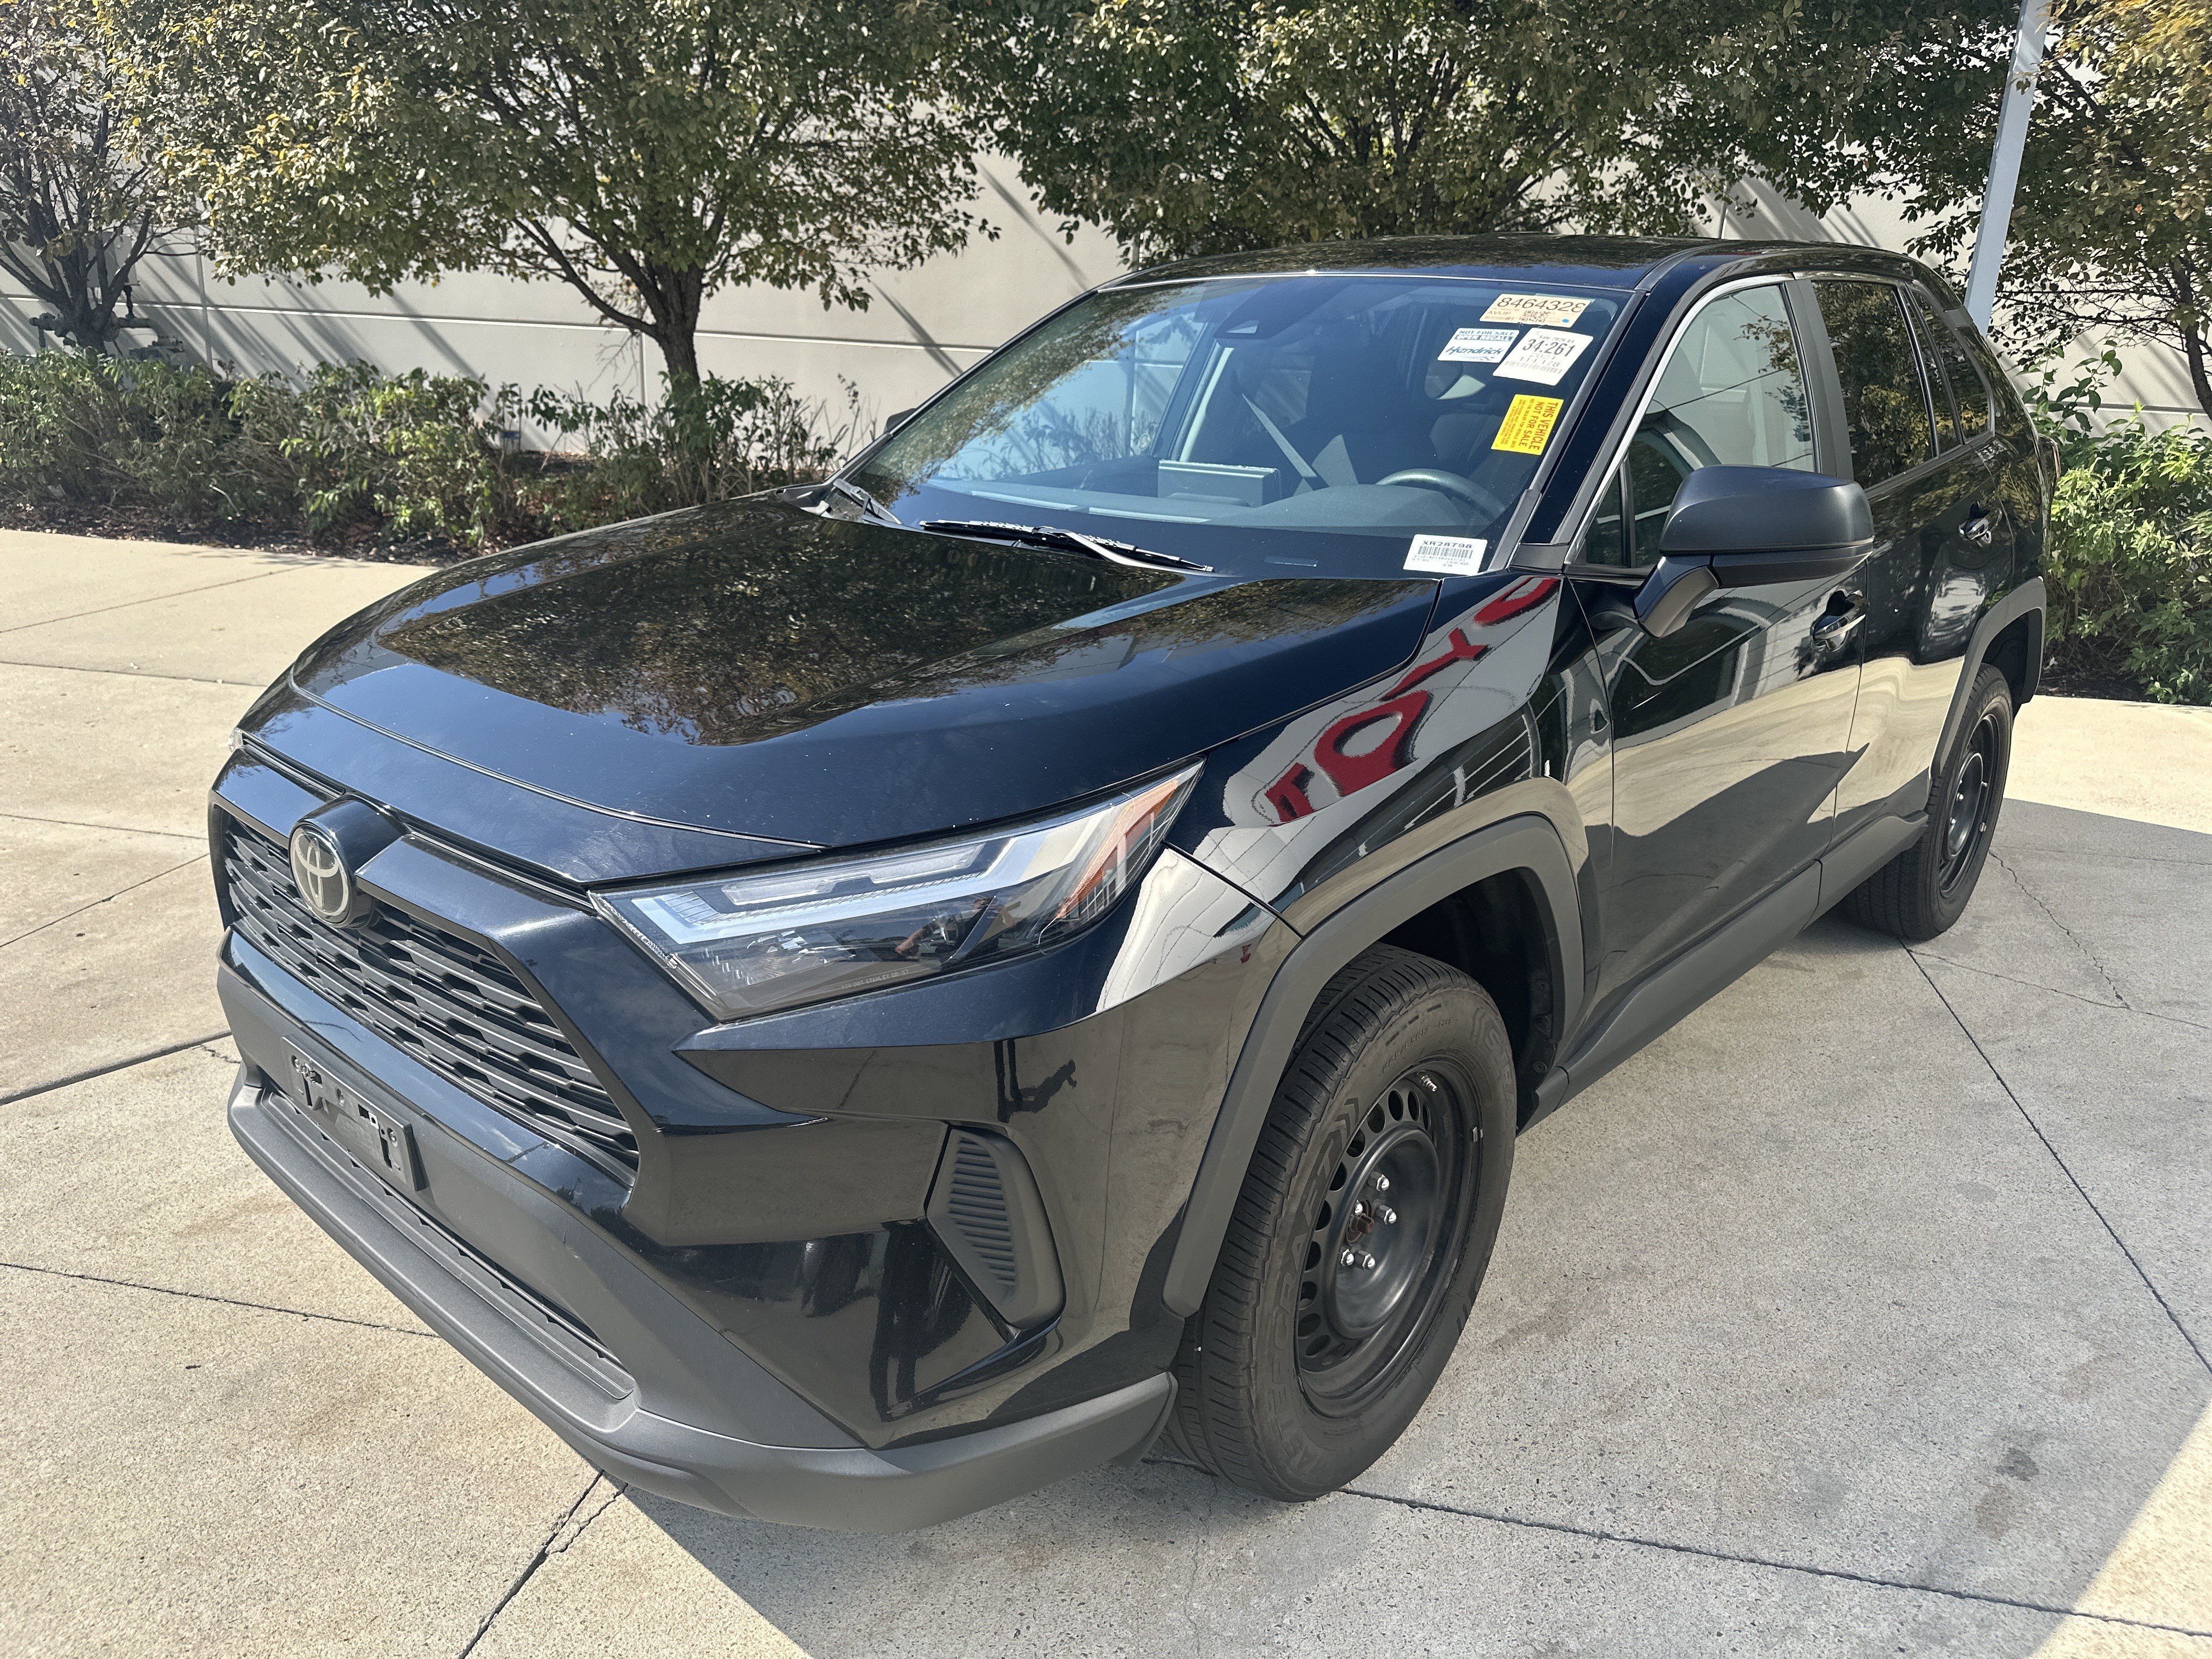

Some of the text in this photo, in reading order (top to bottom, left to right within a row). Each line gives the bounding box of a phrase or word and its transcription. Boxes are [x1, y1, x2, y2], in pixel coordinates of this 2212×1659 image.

[1517, 401, 1545, 447] NOT FOR SALE
[1528, 402, 1559, 450] THIS VEHICLE
[1423, 540, 1472, 549] XR28798
[866, 975, 889, 984] STANLEY
